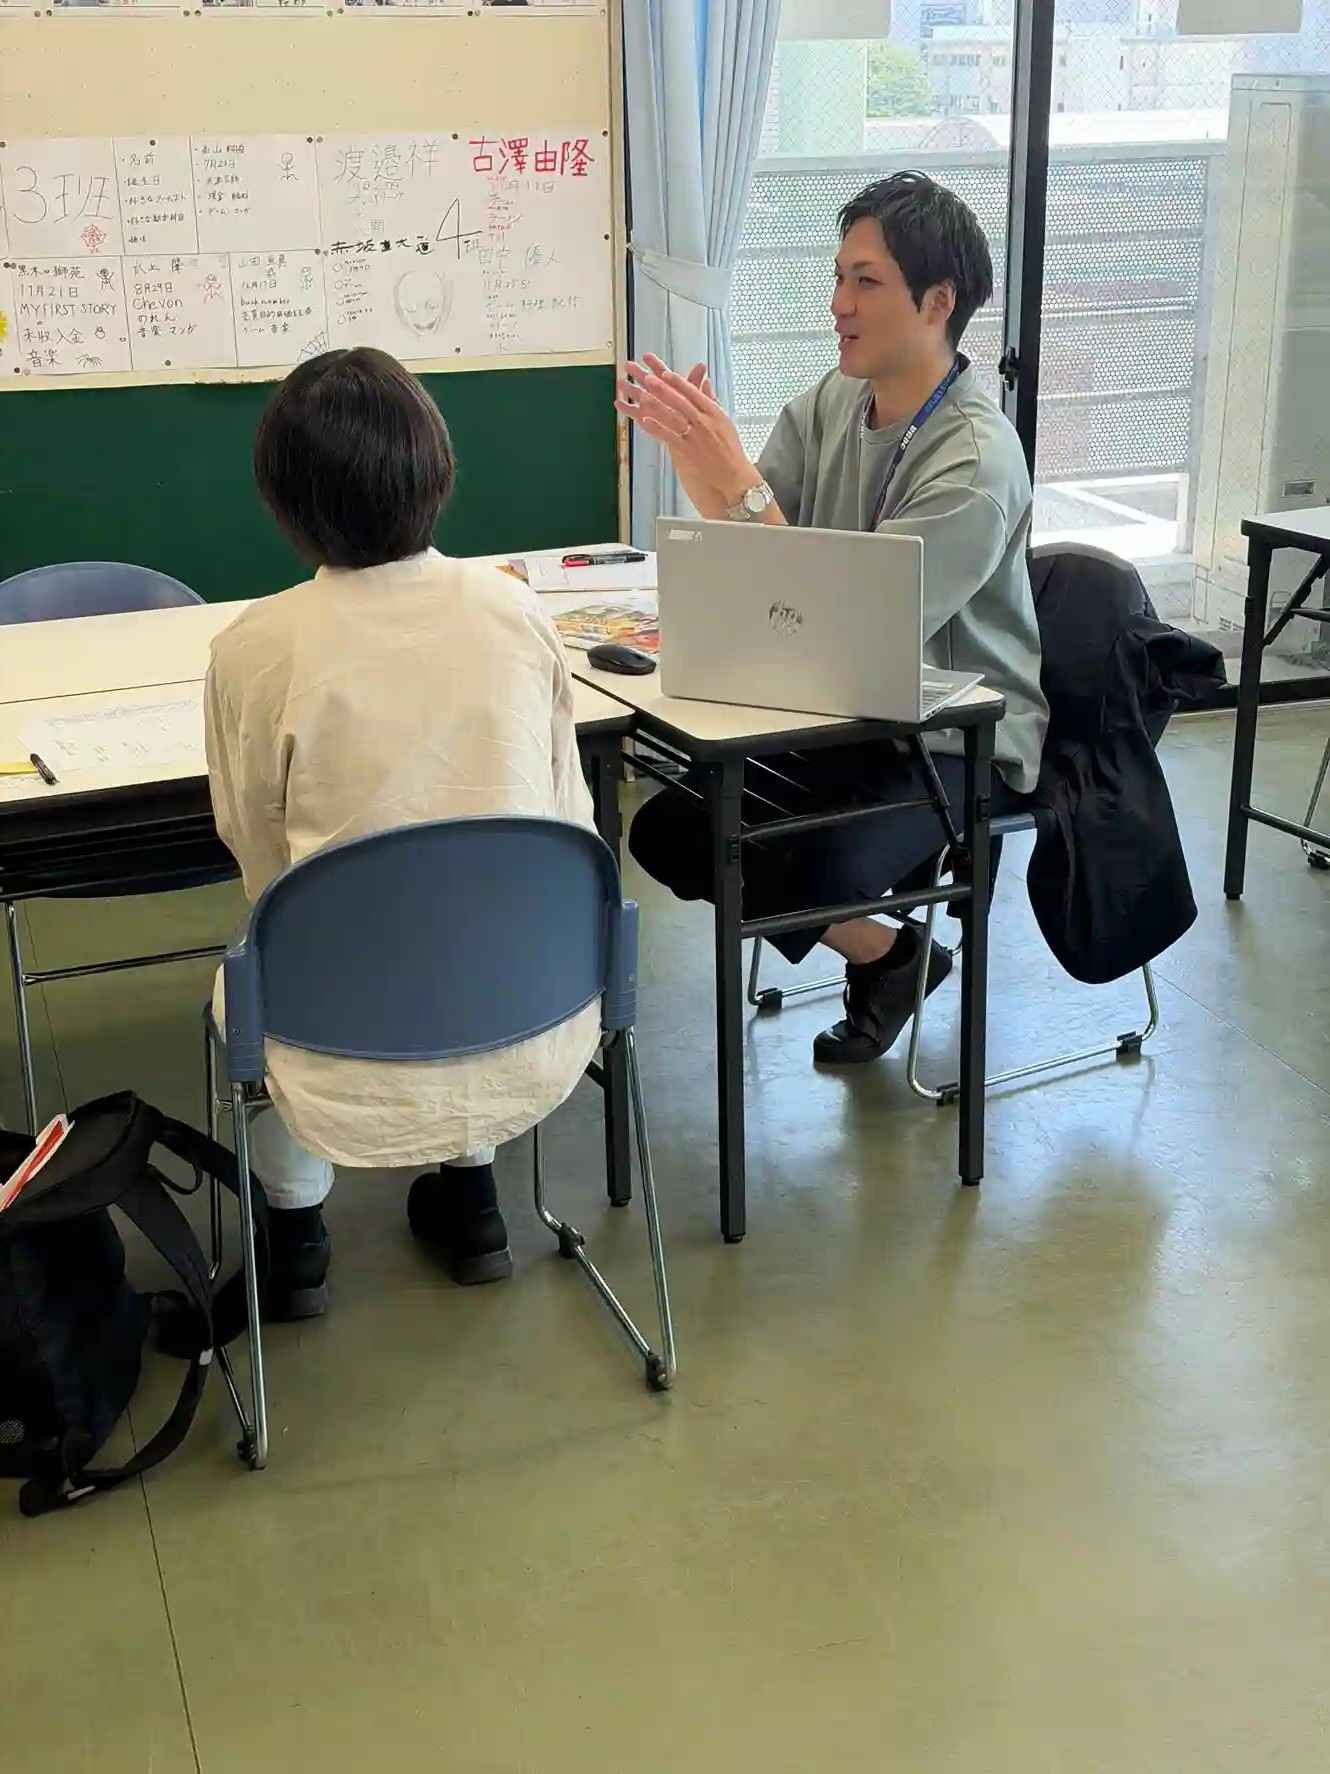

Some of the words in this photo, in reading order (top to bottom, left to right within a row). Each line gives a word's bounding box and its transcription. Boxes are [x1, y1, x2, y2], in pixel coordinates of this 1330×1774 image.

[129, 153, 154, 166] 名前
[12, 166, 113, 223] 3班
[79, 301, 118, 316] STORY
[25, 348, 64, 369] 音楽
